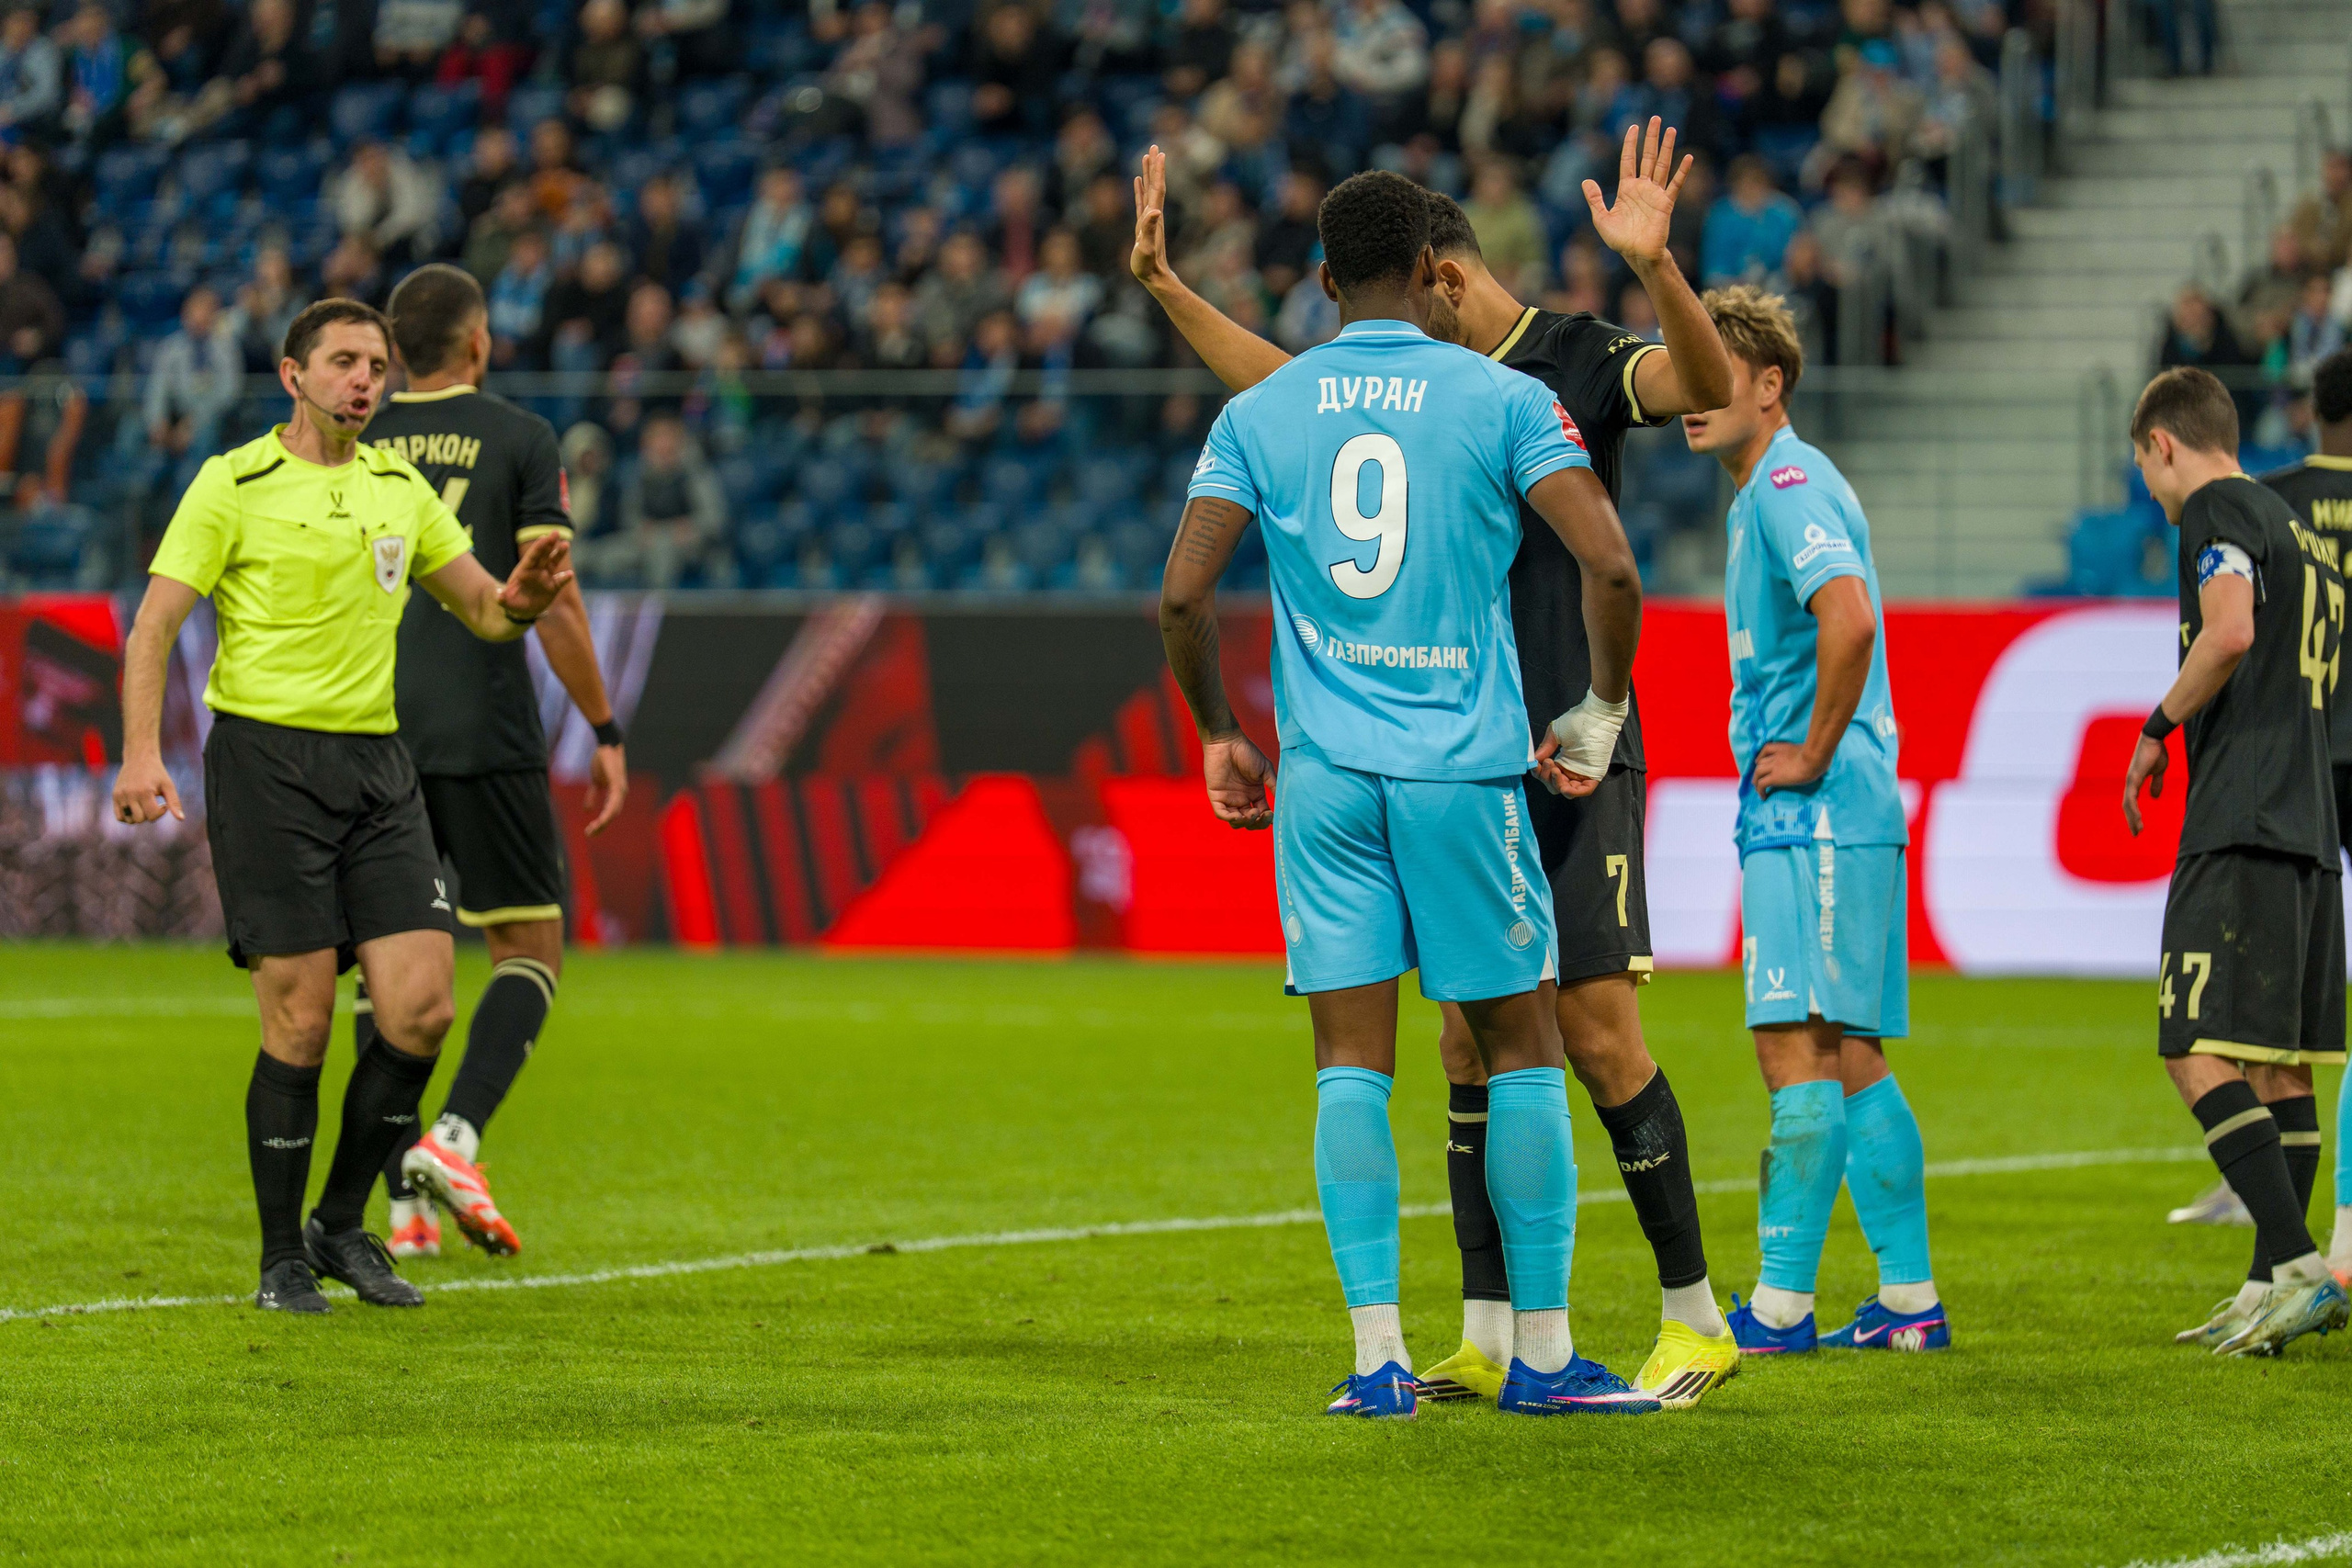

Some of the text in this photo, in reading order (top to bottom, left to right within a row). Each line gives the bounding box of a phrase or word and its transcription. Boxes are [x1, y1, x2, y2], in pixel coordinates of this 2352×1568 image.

[1317, 376, 1428, 414] ДУРАН
[1772, 468, 1805, 485] wb
[1329, 433, 1408, 600] 9
[1327, 636, 1469, 669] ГАЗПРОМБАНК
[2300, 563, 2346, 711] 47
[1502, 792, 1526, 912] ГАЗПРОМБАНК
[1606, 854, 1629, 927] 7
[2158, 952, 2211, 1020] 47
